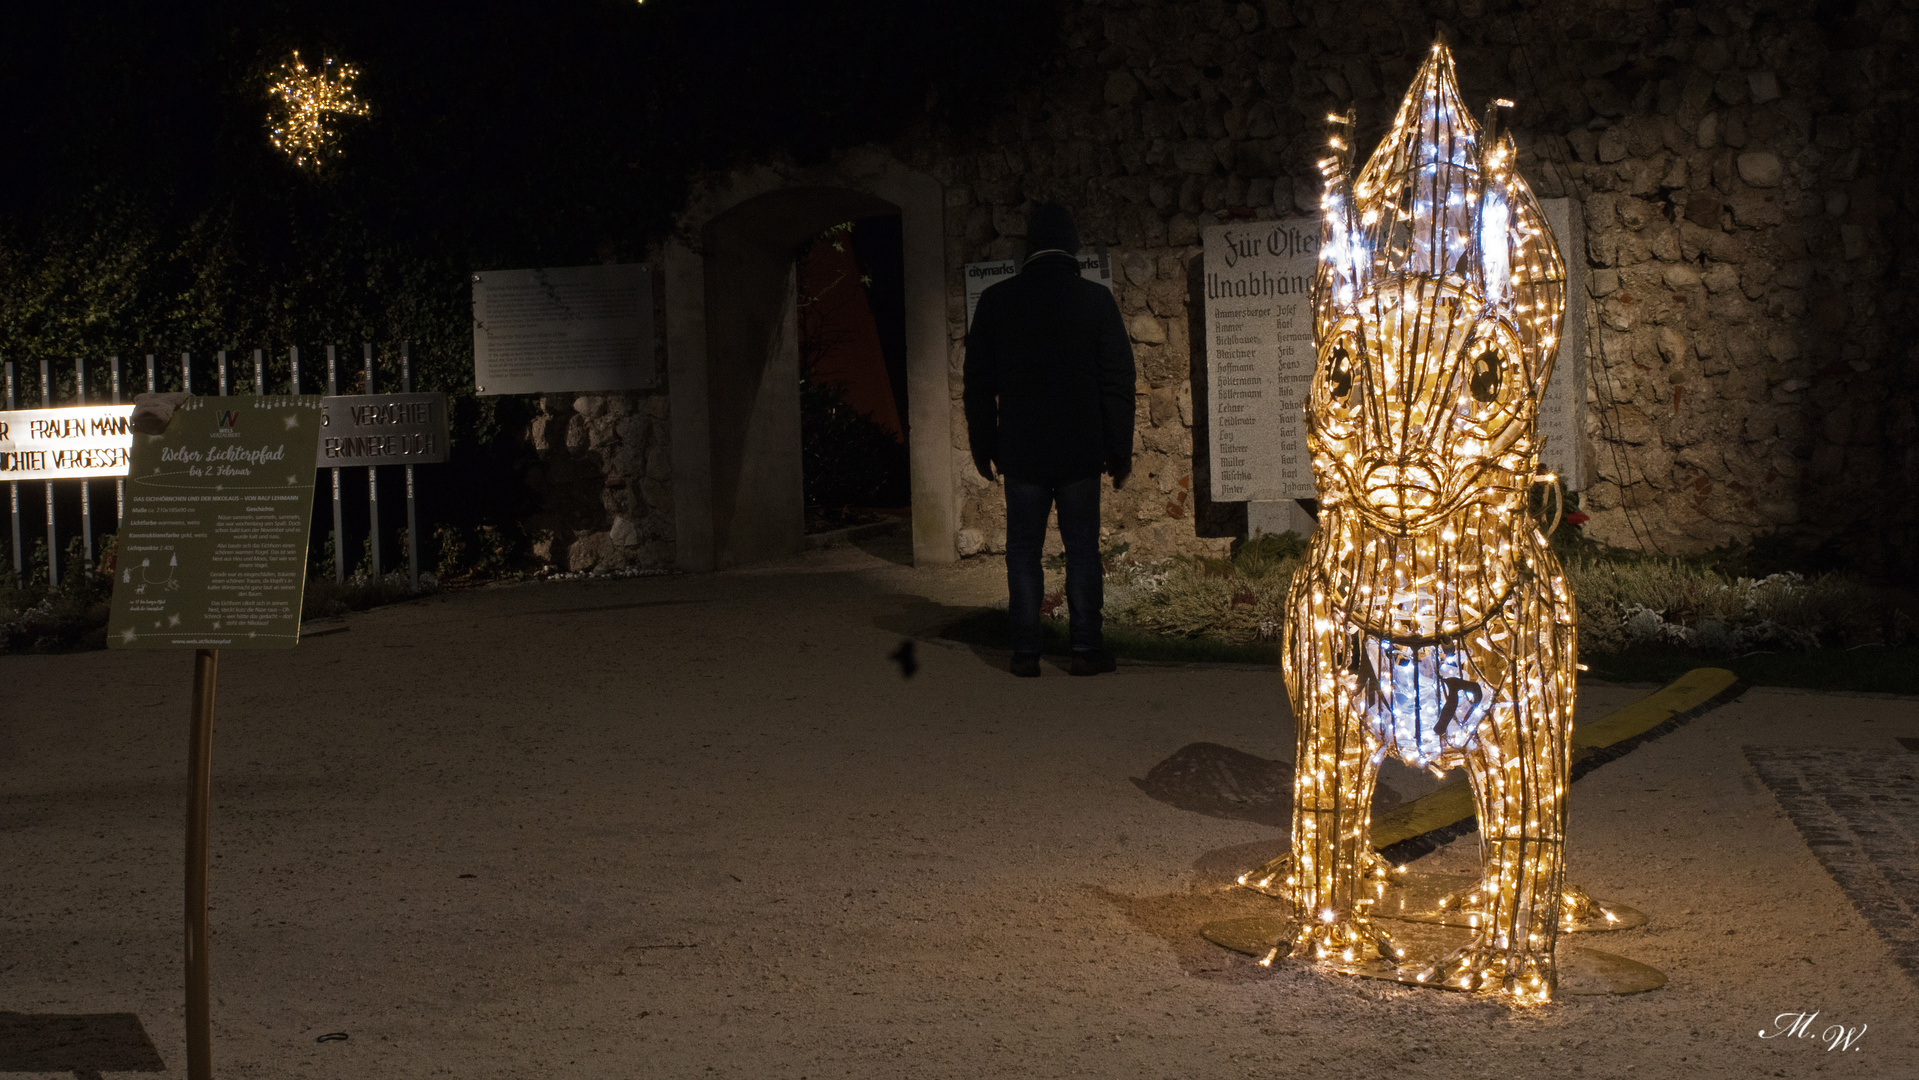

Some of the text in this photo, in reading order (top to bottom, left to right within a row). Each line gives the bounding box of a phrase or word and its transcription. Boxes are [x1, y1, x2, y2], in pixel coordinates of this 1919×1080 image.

[1224, 231, 1261, 268] Für
[1079, 258, 1099, 269] arks
[969, 264, 1014, 278] citymarks
[1215, 304, 1296, 318] Ammersberger Josef
[1215, 319, 1292, 332] Ammer Karl
[1278, 332, 1311, 343] Hermann
[1278, 346, 1294, 358] Fritz
[1217, 360, 1300, 375] Hoffmann Franz
[1278, 373, 1312, 383] Hermann
[1218, 400, 1303, 413] Lehner Jakob
[351, 402, 433, 426] VERACHTET
[1280, 414, 1296, 423] Karl
[31, 419, 85, 439] FRAUEN
[92, 413, 132, 436] MÄNN
[1280, 427, 1296, 437] Karl
[325, 433, 435, 458] ERINNERE DICH
[1281, 441, 1296, 450] Karl
[162, 445, 285, 465] Welser Lichterpfad
[1220, 455, 1297, 467] Müller Karl
[190, 465, 251, 477] bis 2. Februar
[1282, 469, 1297, 478] Karl
[1283, 483, 1311, 494] Johann
